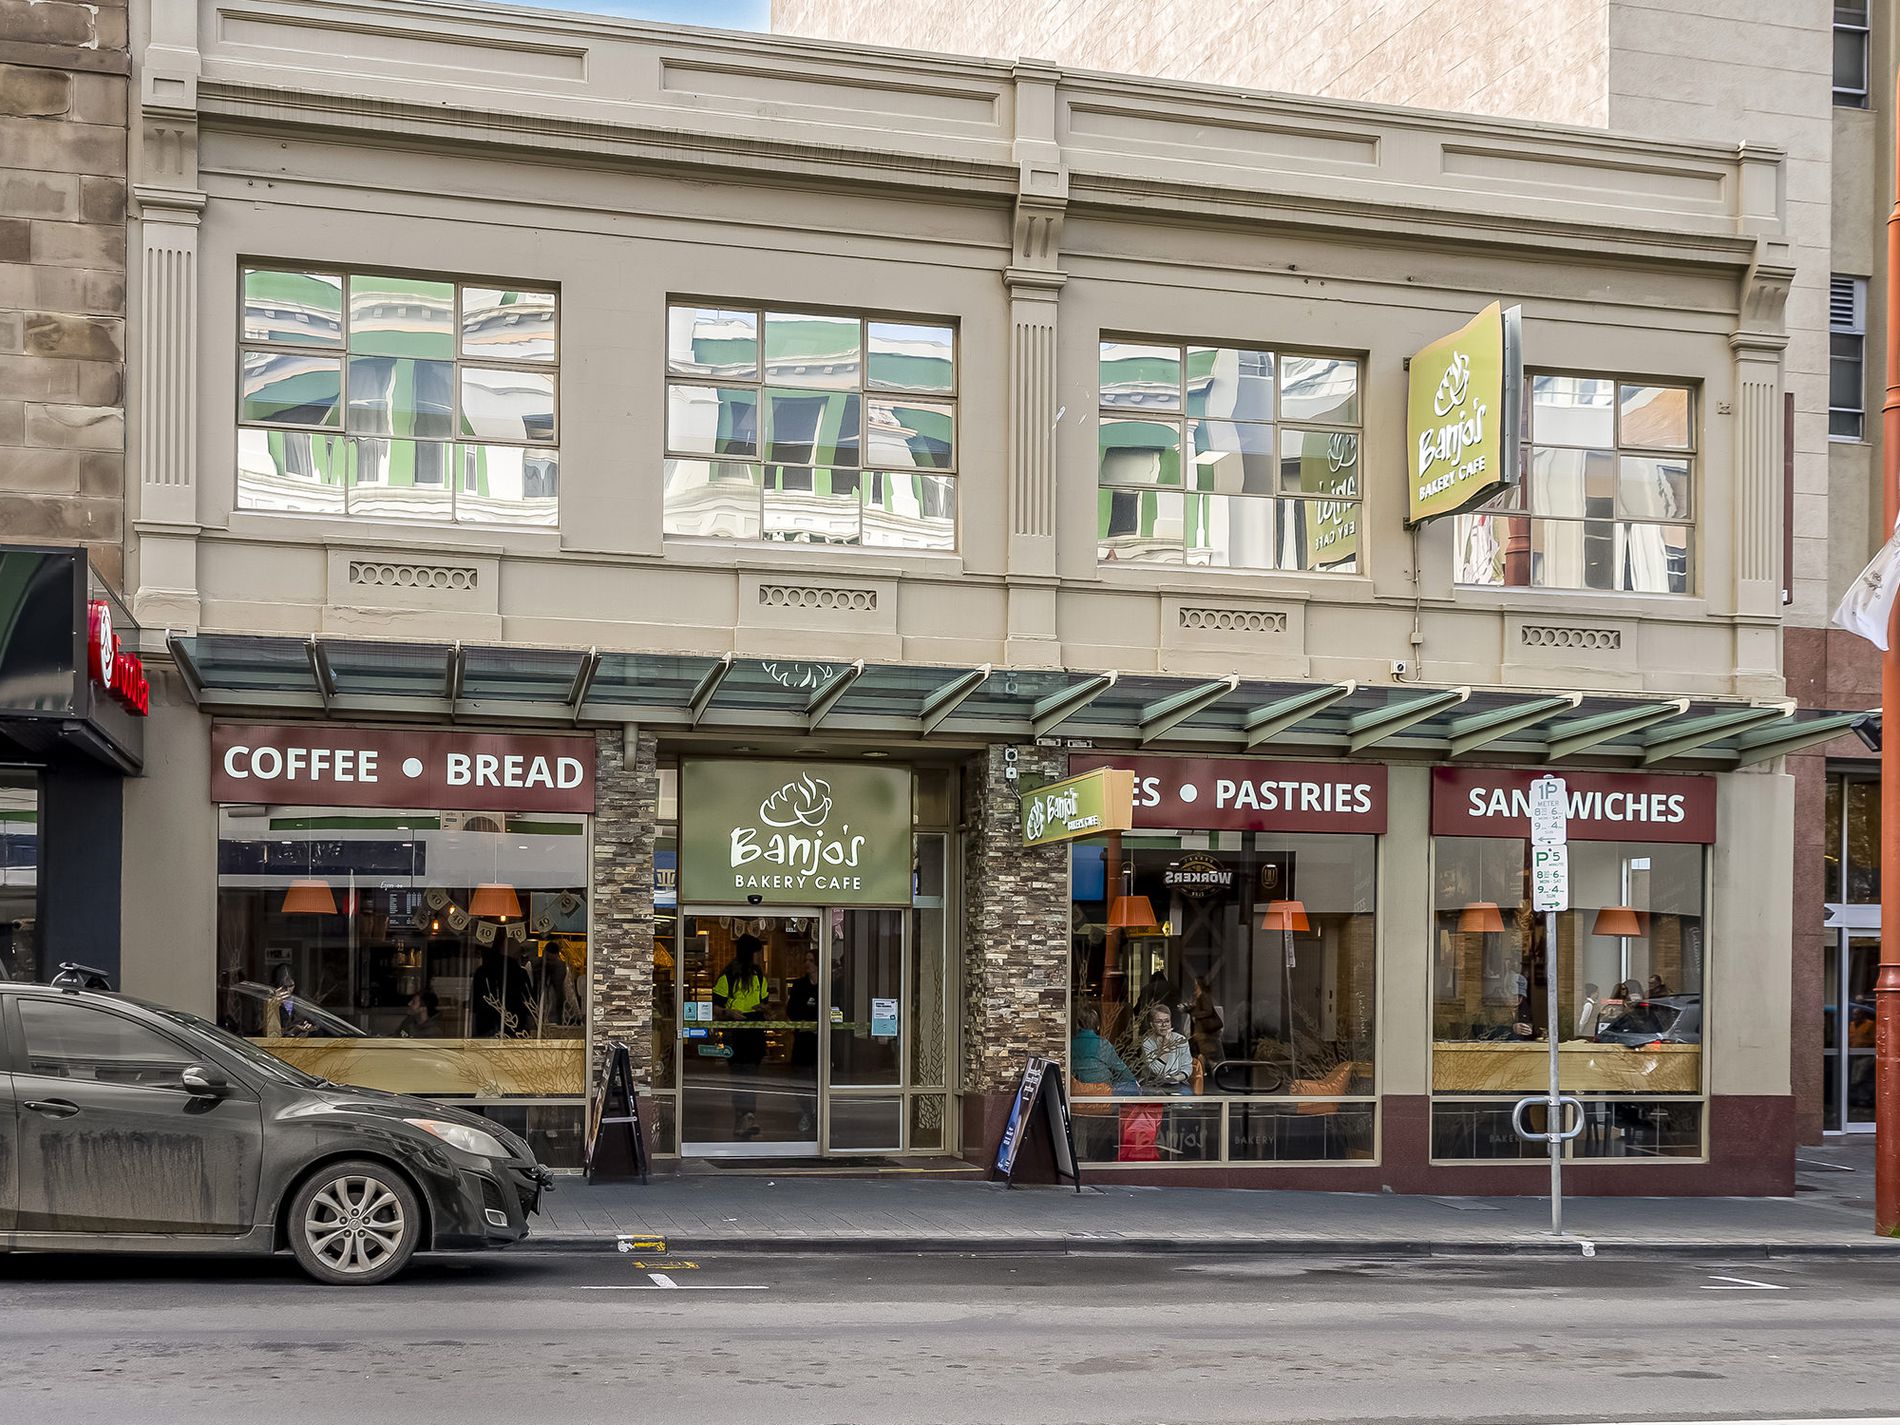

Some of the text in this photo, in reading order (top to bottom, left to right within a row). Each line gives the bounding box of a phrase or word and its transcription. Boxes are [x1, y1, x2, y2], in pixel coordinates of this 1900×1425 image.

[1418, 397, 1486, 478] Banjo's
[1419, 455, 1486, 501] BAKERY CAFE
[223, 745, 585, 789] COFFEE BREAD
[1215, 779, 1372, 813] PASTRIES
[1468, 787, 1686, 823] SANWICHES
[1538, 784, 1558, 800] 1P
[730, 824, 865, 876] Banjo's
[1536, 851, 1560, 867] P 5
[735, 875, 861, 890] BAKERY CAFE
[480, 928, 492, 937] 40
[1234, 1135, 1275, 1145] BAKERY
